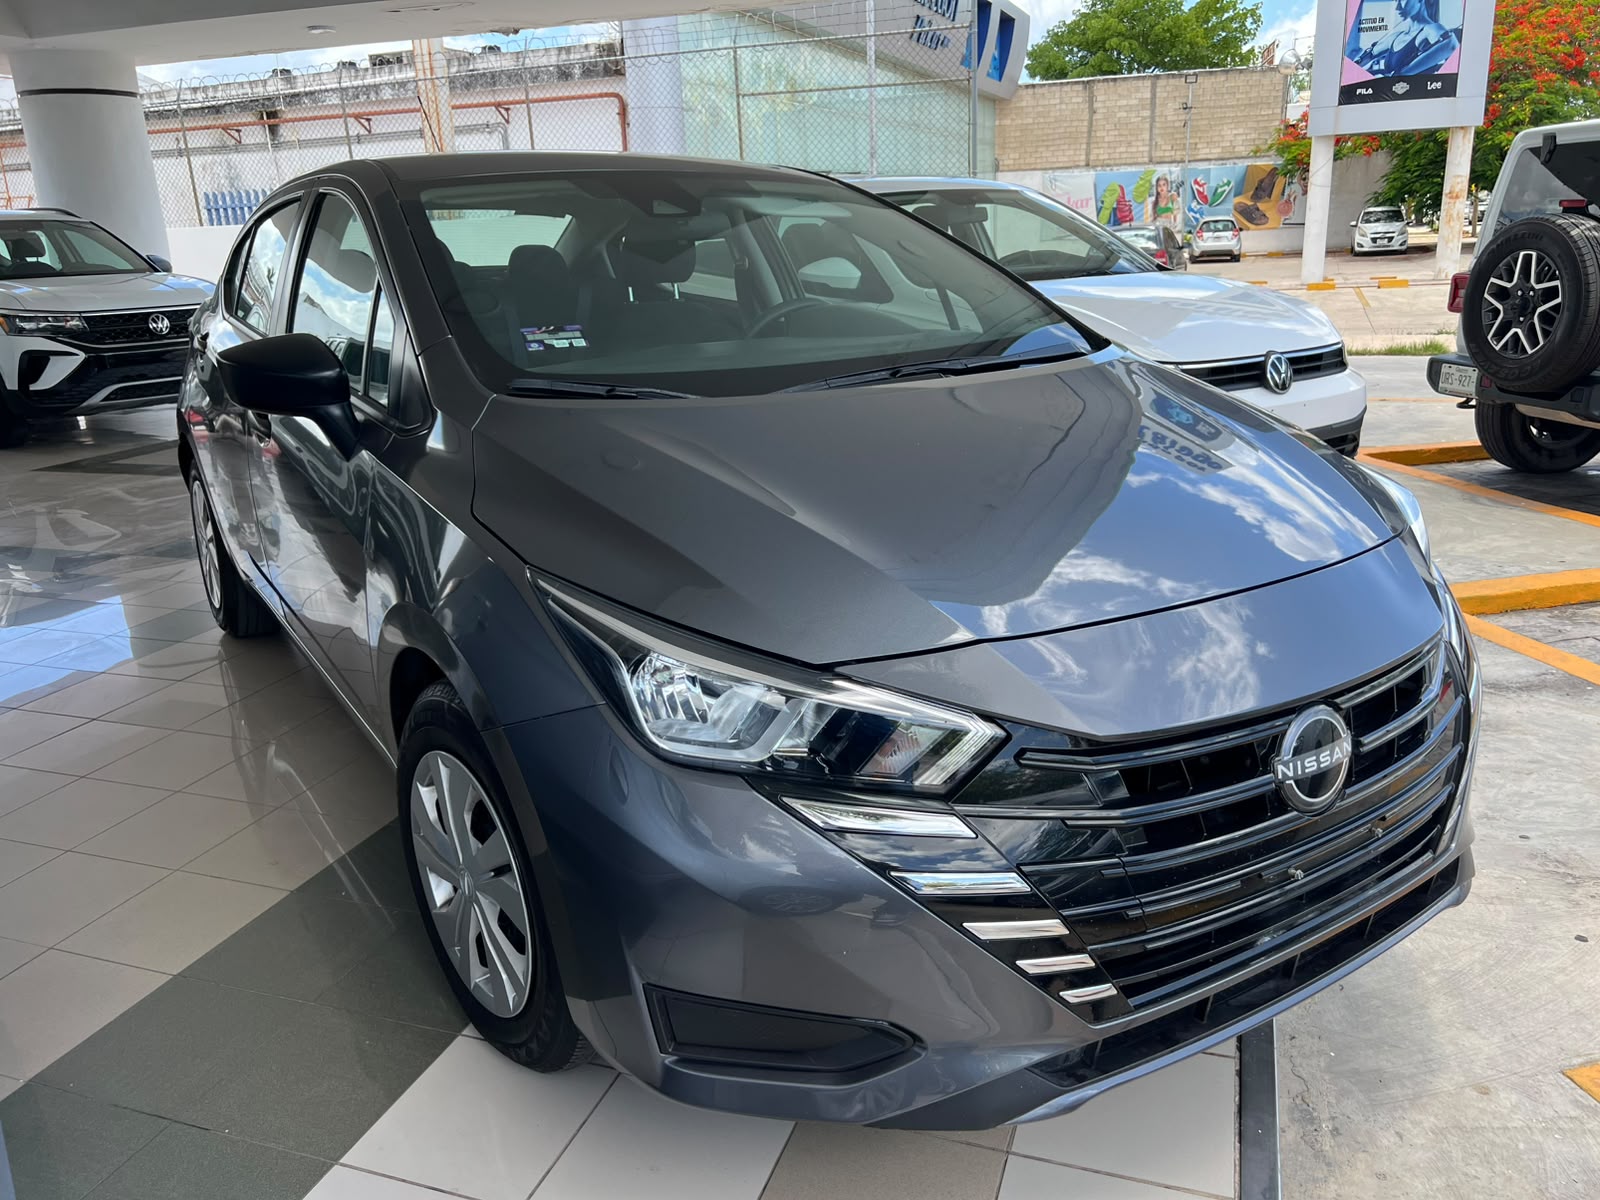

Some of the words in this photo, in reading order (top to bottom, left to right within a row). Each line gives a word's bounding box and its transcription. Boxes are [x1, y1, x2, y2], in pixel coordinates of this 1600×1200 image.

[1358, 18, 1377, 26] ACTITUD
[1427, 81, 1442, 90] Lee
[1356, 87, 1373, 96] FILA
[1277, 739, 1352, 779] NISSAN
